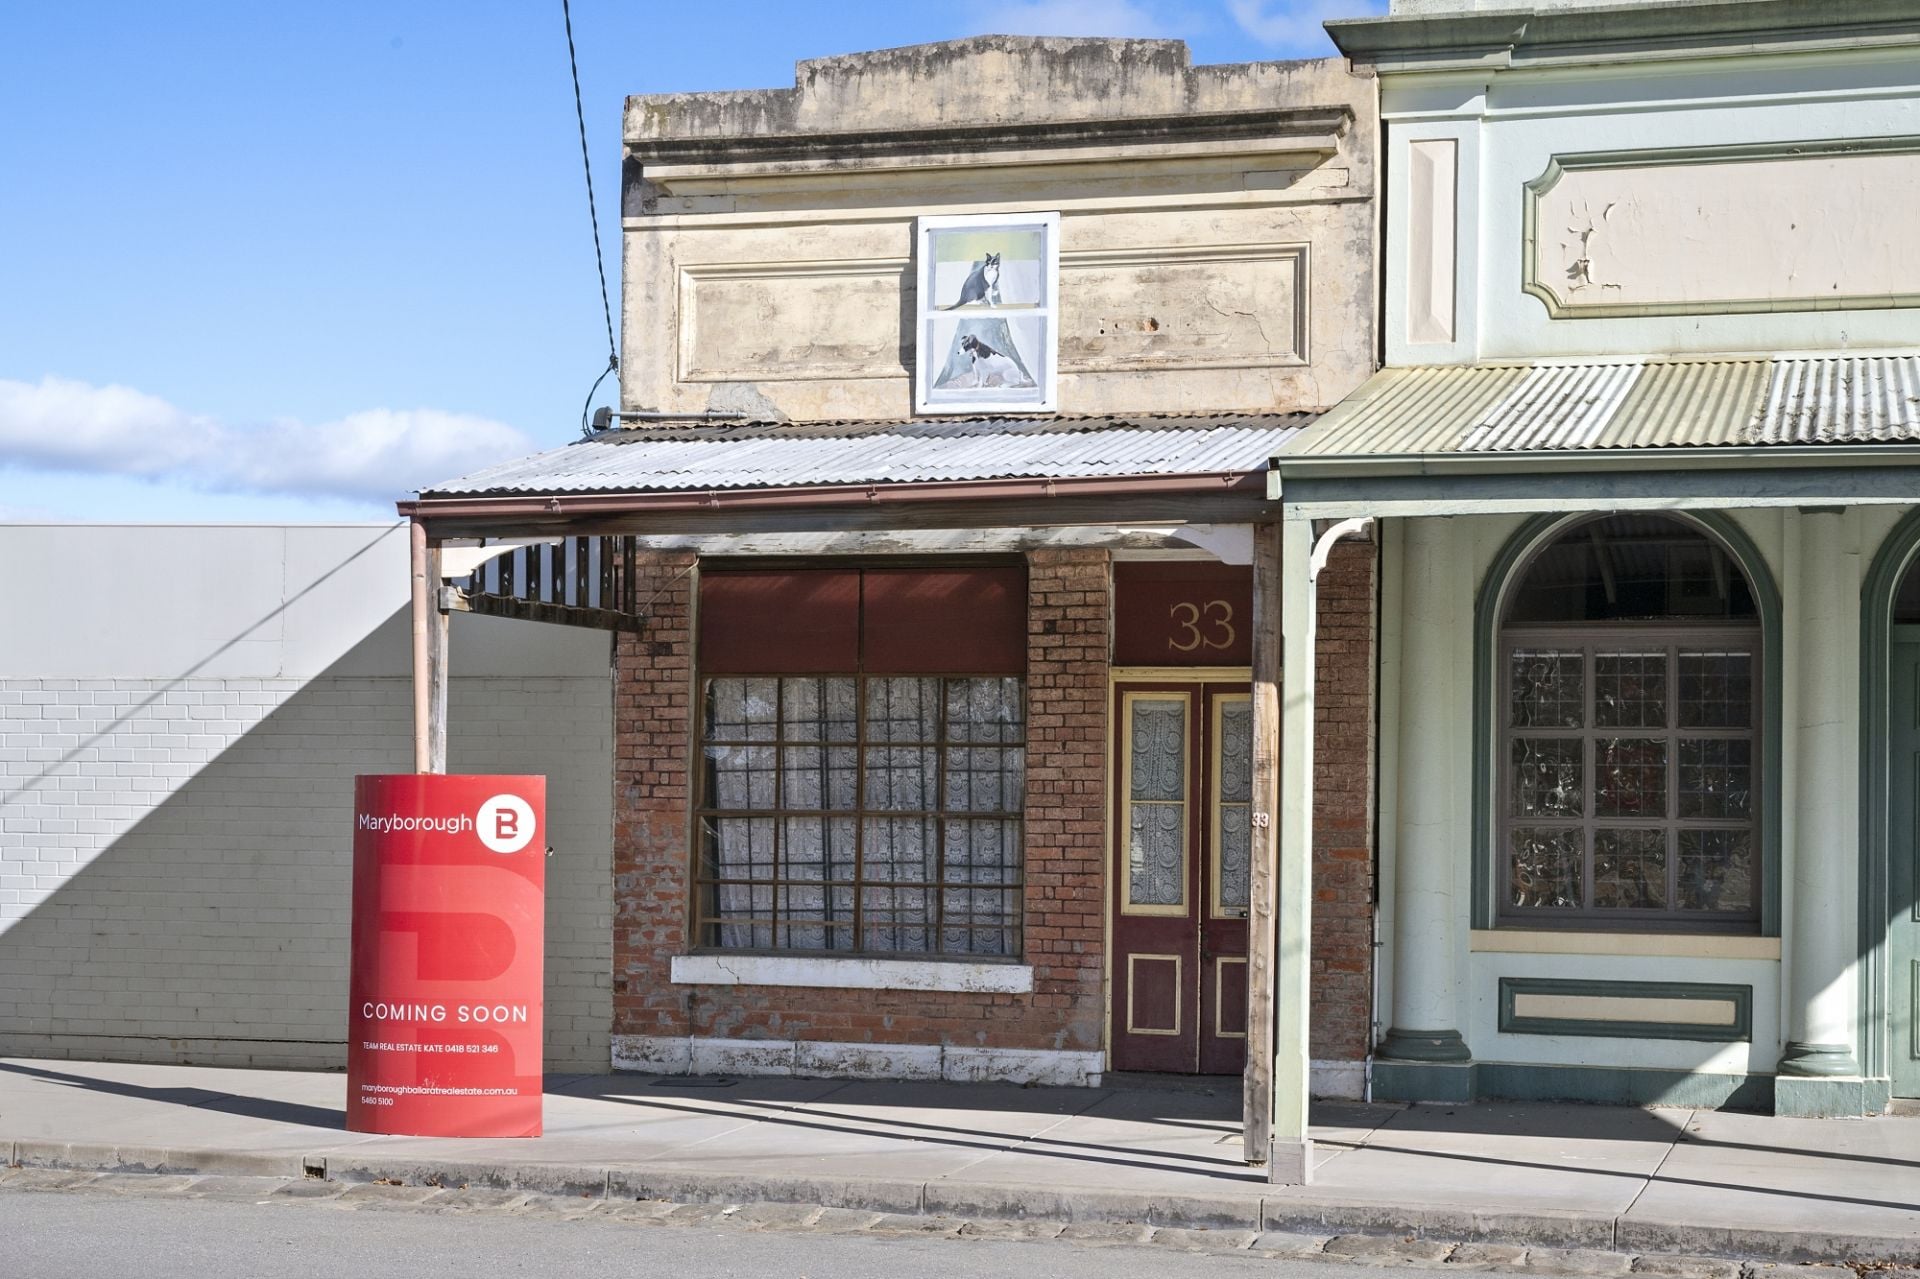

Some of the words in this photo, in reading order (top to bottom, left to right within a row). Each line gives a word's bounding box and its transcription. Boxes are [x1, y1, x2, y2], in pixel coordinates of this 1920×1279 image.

[1168, 600, 1235, 651] 33
[359, 813, 472, 834] Maryborough
[1252, 812, 1269, 828] 33
[363, 1002, 446, 1021] COMING
[458, 1005, 527, 1022] SOON
[363, 1042, 378, 1050] TEAM
[379, 1043, 396, 1051] REAL
[396, 1044, 422, 1052] ESTATE
[445, 1045, 465, 1053] 0418
[466, 1045, 480, 1053] 521
[481, 1045, 499, 1053] 346
[361, 1085, 518, 1096] maryboroughballaratrealestate.com.au
[378, 1098, 393, 1106] 5100
